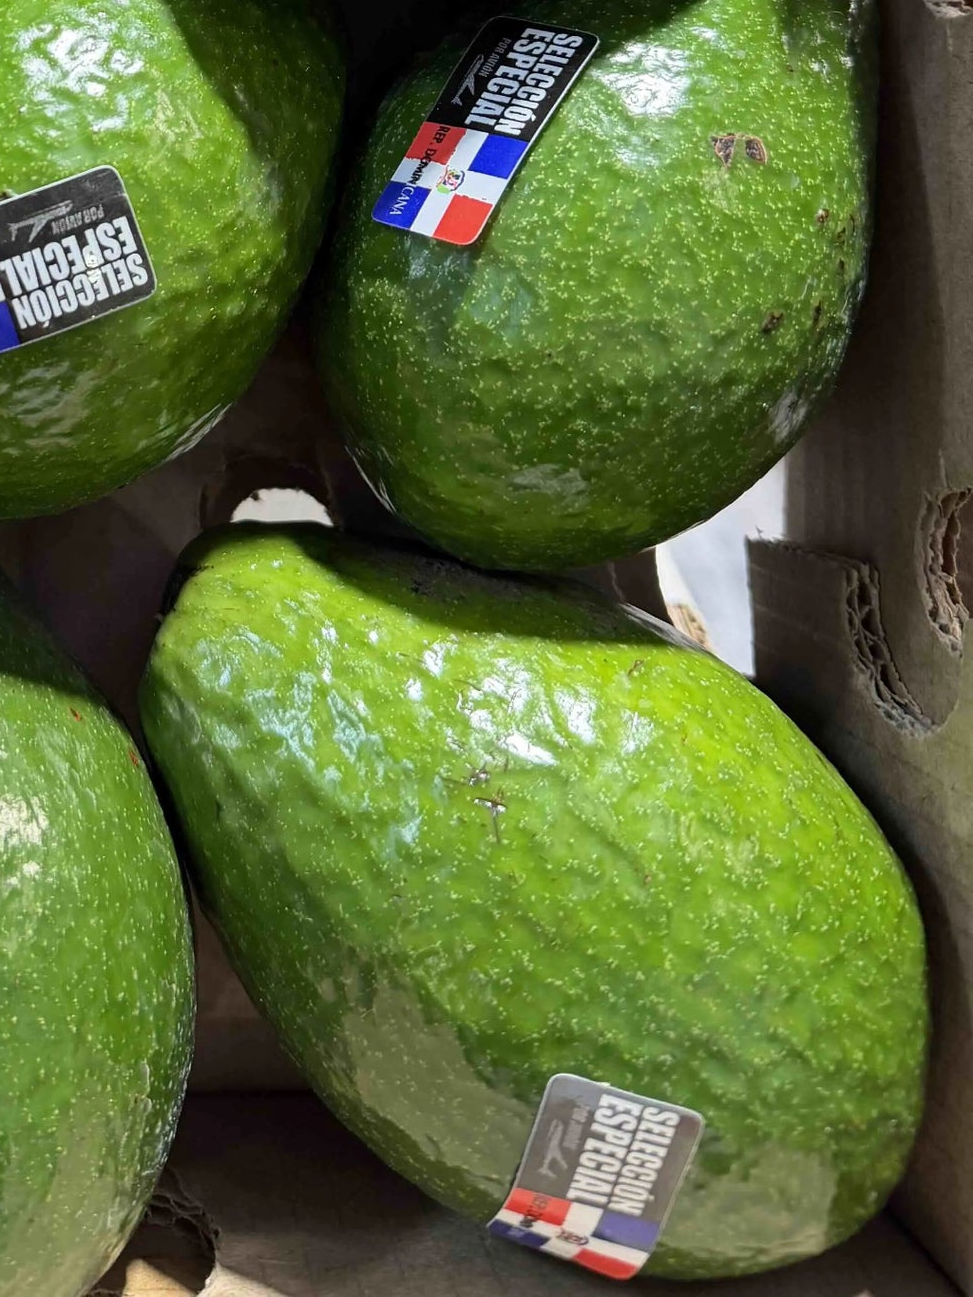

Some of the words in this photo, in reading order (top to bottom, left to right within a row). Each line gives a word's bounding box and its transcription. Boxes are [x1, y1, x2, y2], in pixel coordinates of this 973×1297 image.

[465, 28, 550, 130] ESPECIAL
[494, 33, 583, 136] SELECCIÓN
[495, 38, 512, 55] POR
[430, 125, 450, 146] REP.
[84, 204, 105, 224] POR
[389, 147, 436, 215] DOMINICANA
[12, 253, 148, 330] SELECCIÓN
[566, 1094, 643, 1204] ESPECIAL
[608, 1106, 680, 1217] SELECCIÓN
